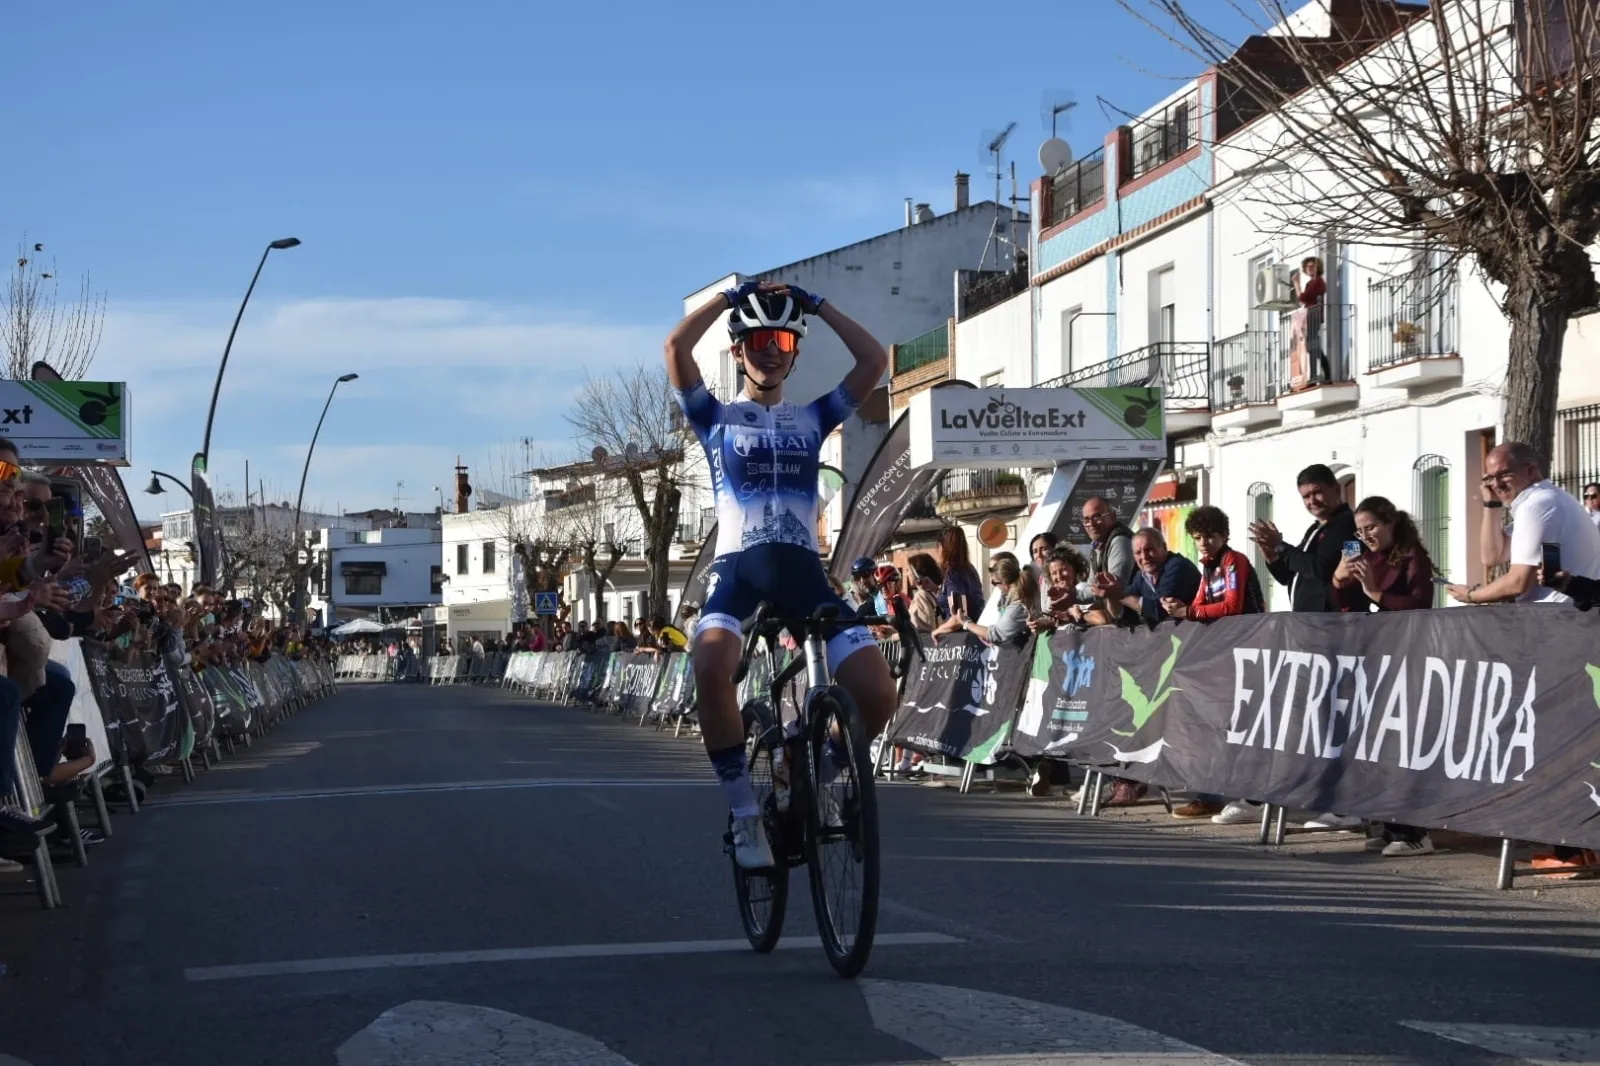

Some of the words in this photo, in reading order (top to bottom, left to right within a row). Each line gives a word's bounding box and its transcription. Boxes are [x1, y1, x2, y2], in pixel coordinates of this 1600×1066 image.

[941, 408, 1086, 429] LaVueltaExt
[857, 465, 897, 510] FEDERACIÓN
[863, 500, 878, 516] DE
[1227, 648, 1536, 783] EXTREMADURA
